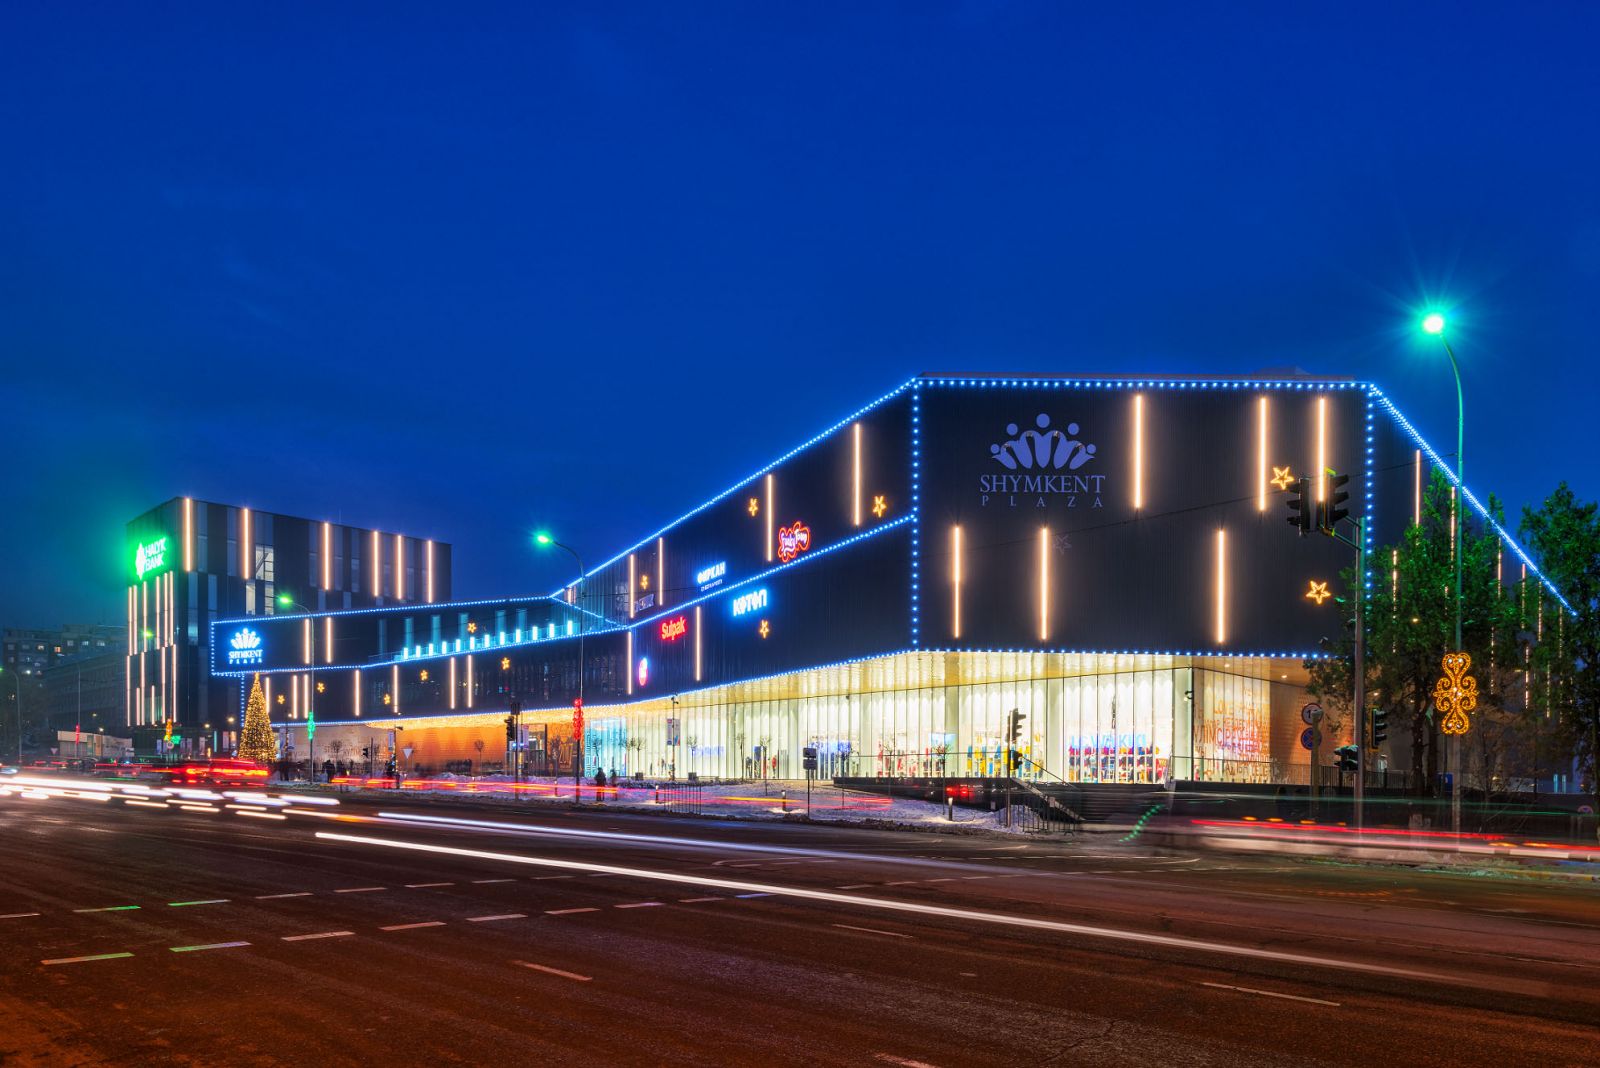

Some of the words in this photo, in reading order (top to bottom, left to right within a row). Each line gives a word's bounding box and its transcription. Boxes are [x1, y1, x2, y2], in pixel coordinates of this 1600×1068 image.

[980, 474, 1106, 493] SHYMKENT
[981, 495, 1104, 508] PLAZA
[145, 537, 167, 557] HALYK
[145, 551, 165, 571] BANK
[661, 616, 686, 641] Sulpak
[228, 649, 263, 659] SHYMKENT
